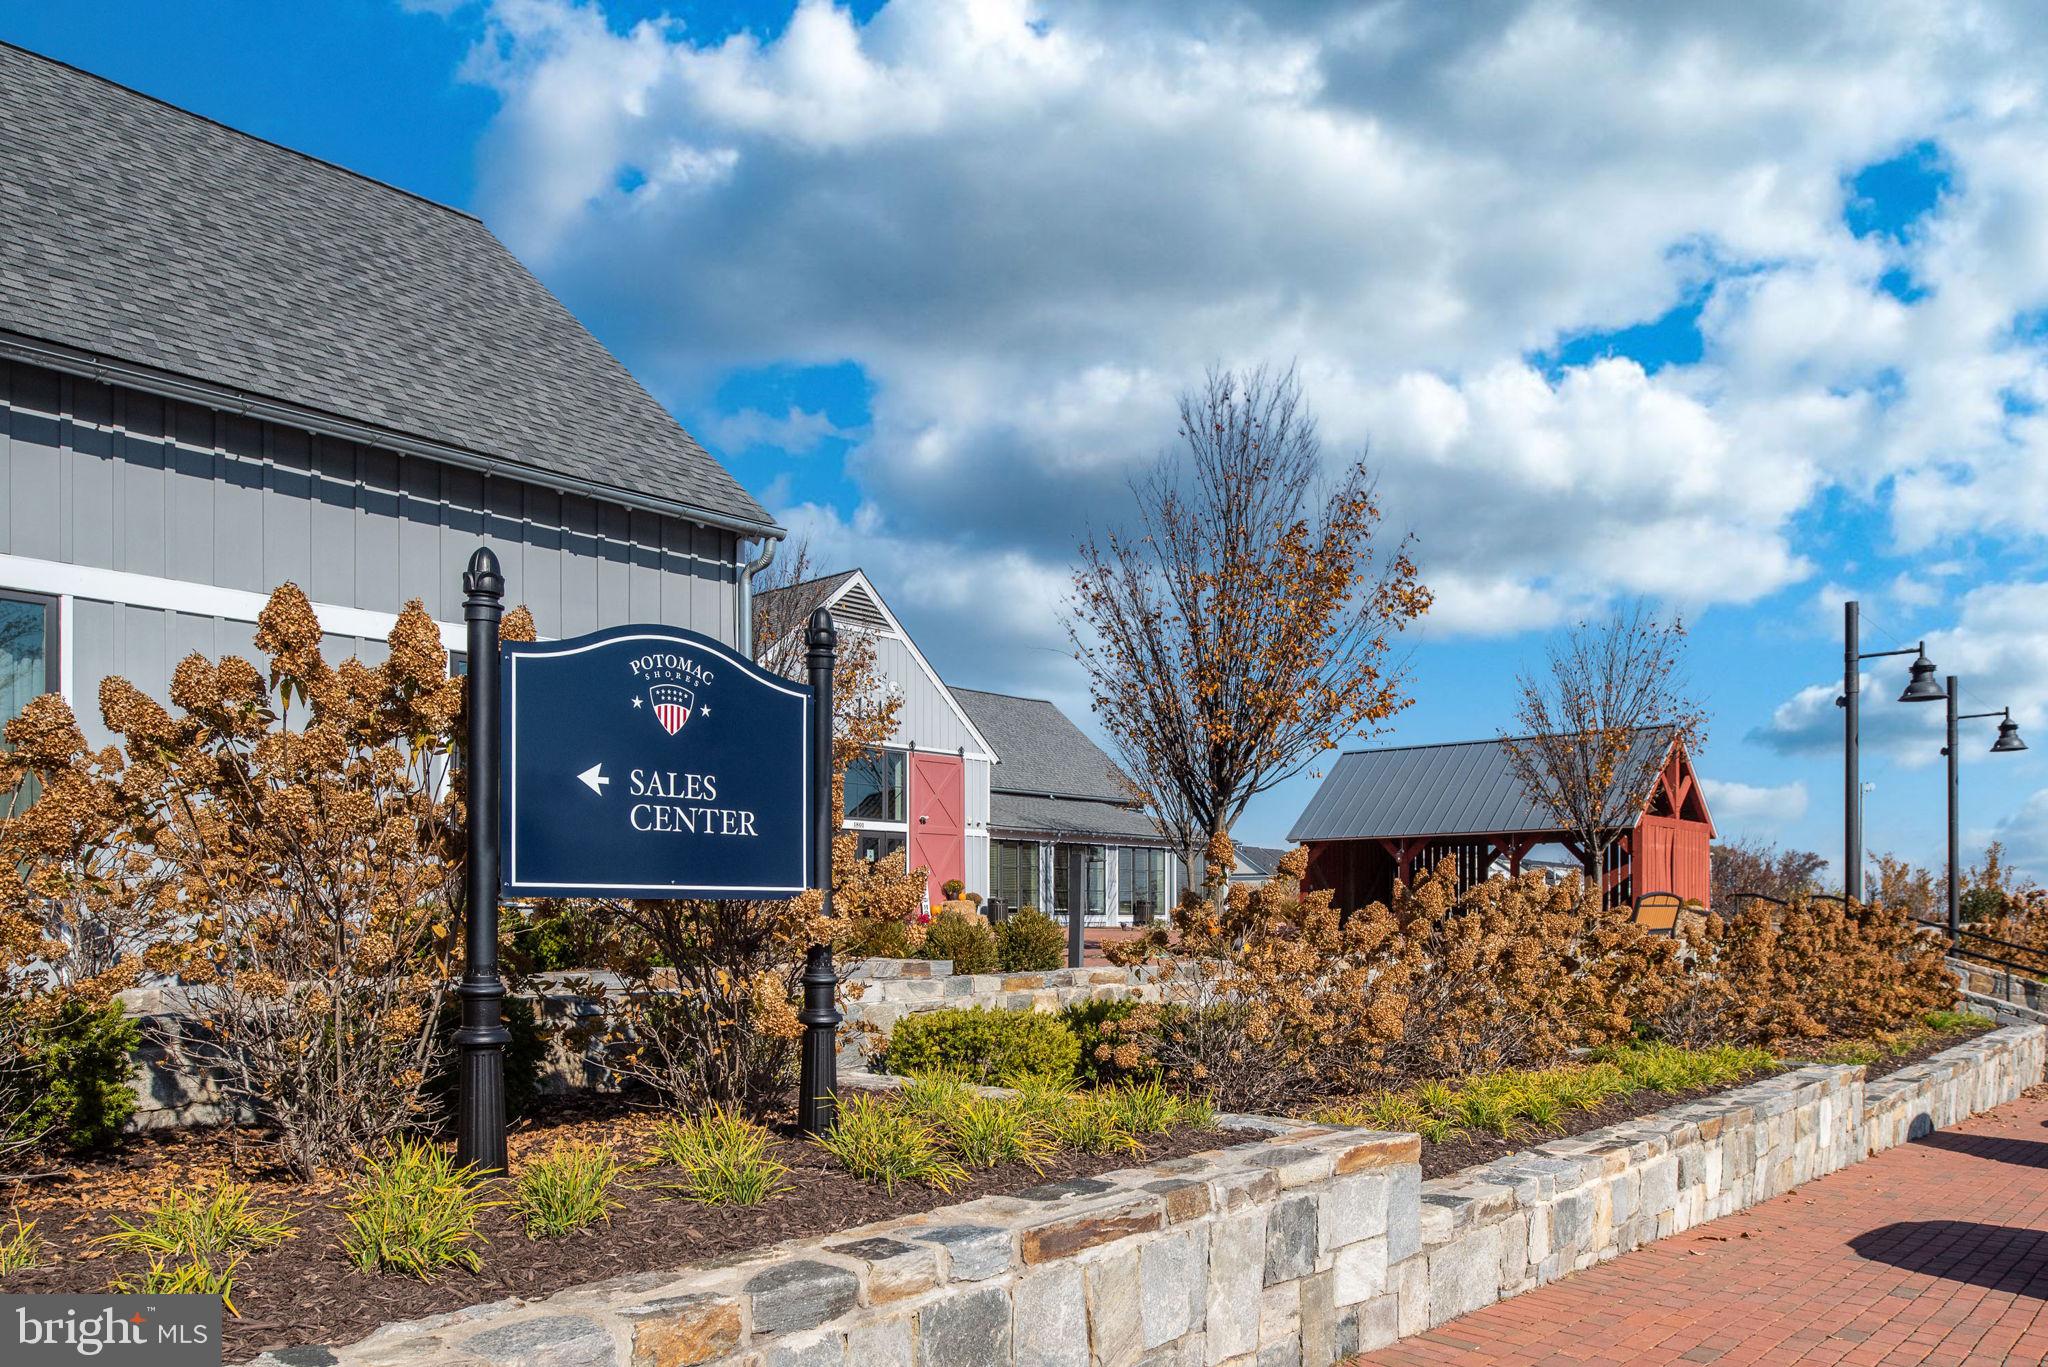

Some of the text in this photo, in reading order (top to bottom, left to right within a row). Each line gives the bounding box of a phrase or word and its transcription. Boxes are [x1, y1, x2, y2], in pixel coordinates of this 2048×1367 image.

[629, 654, 714, 686] POTOMAC
[645, 671, 700, 687] SHORES
[630, 769, 717, 801] SALES
[630, 804, 759, 836] CENTER
